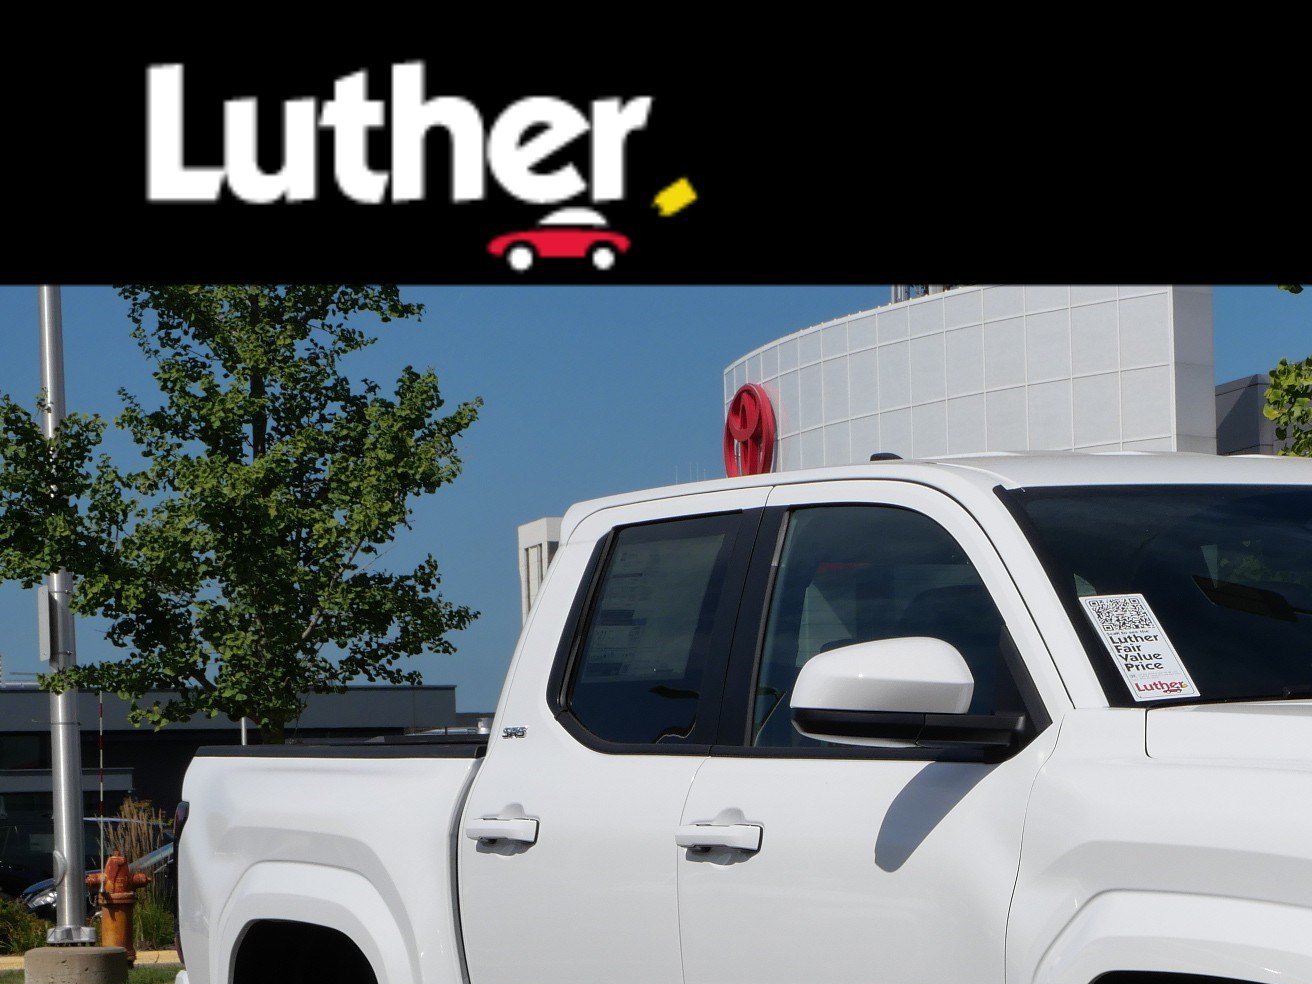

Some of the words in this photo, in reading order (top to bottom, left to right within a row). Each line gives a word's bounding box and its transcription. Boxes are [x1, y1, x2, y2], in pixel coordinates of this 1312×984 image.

[1109, 634, 1158, 644] Luther
[1114, 643, 1141, 653] Fair
[1118, 652, 1162, 662] Value
[1124, 661, 1164, 672] Price
[1135, 681, 1184, 692] Luther
